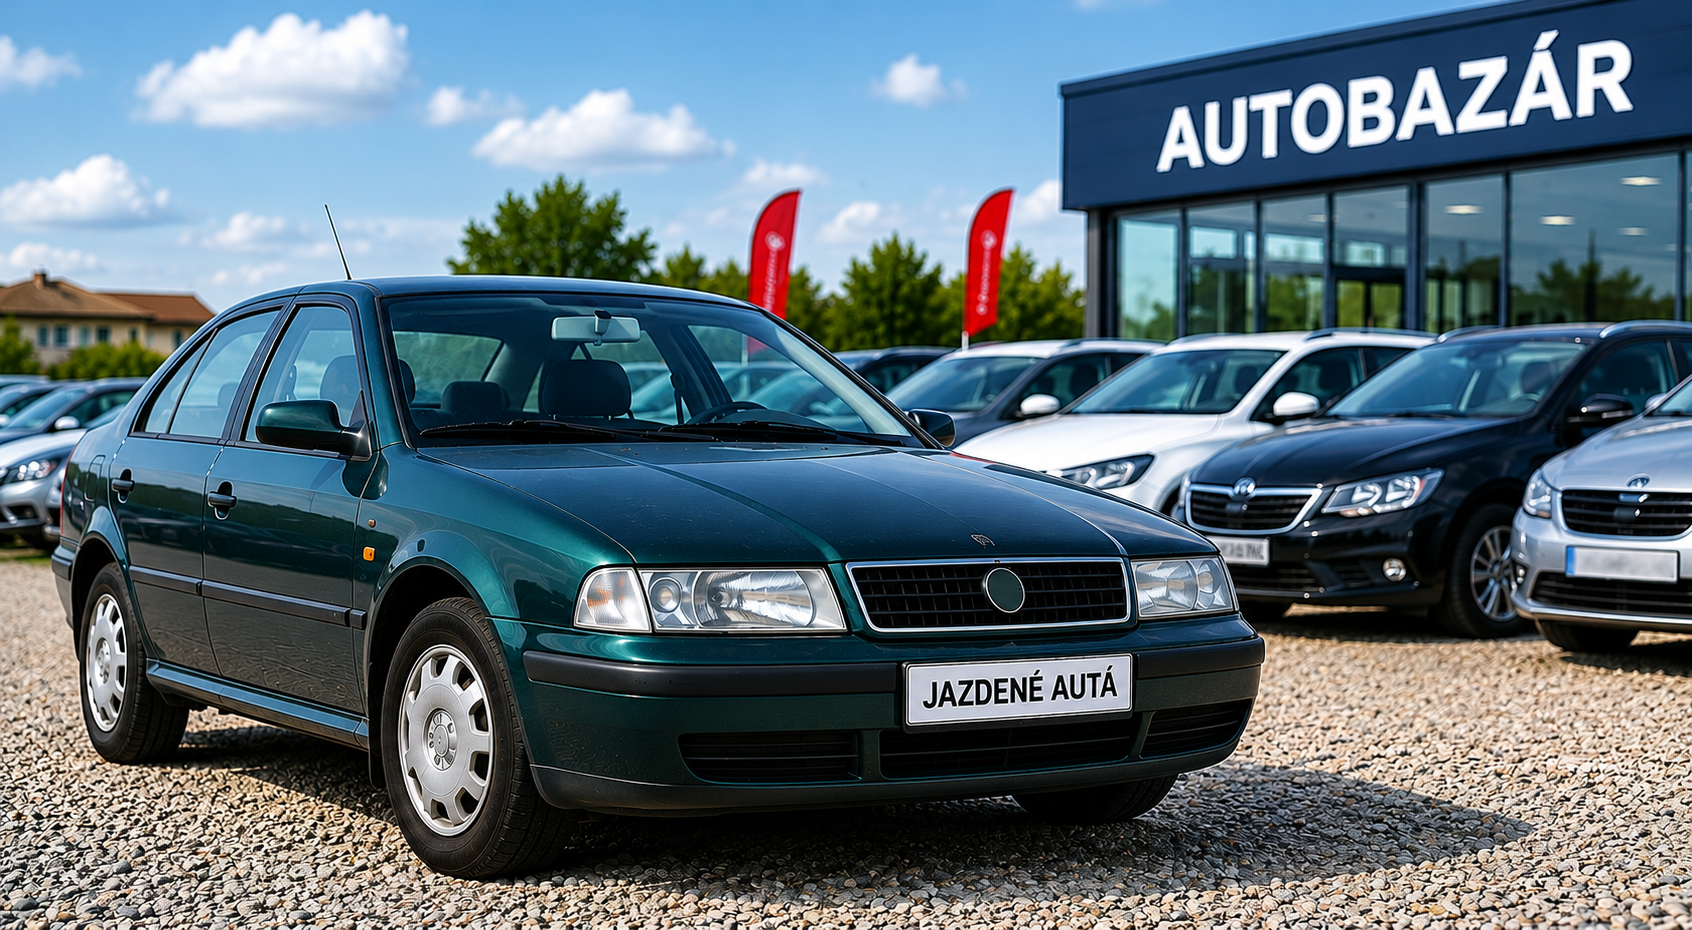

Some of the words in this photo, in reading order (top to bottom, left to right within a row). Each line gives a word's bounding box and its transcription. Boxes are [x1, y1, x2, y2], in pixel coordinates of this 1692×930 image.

[1156, 29, 1633, 173] AUTOBAZÁR
[922, 669, 1044, 709] JAZDENÉ
[1051, 665, 1118, 701] AUTÁ
